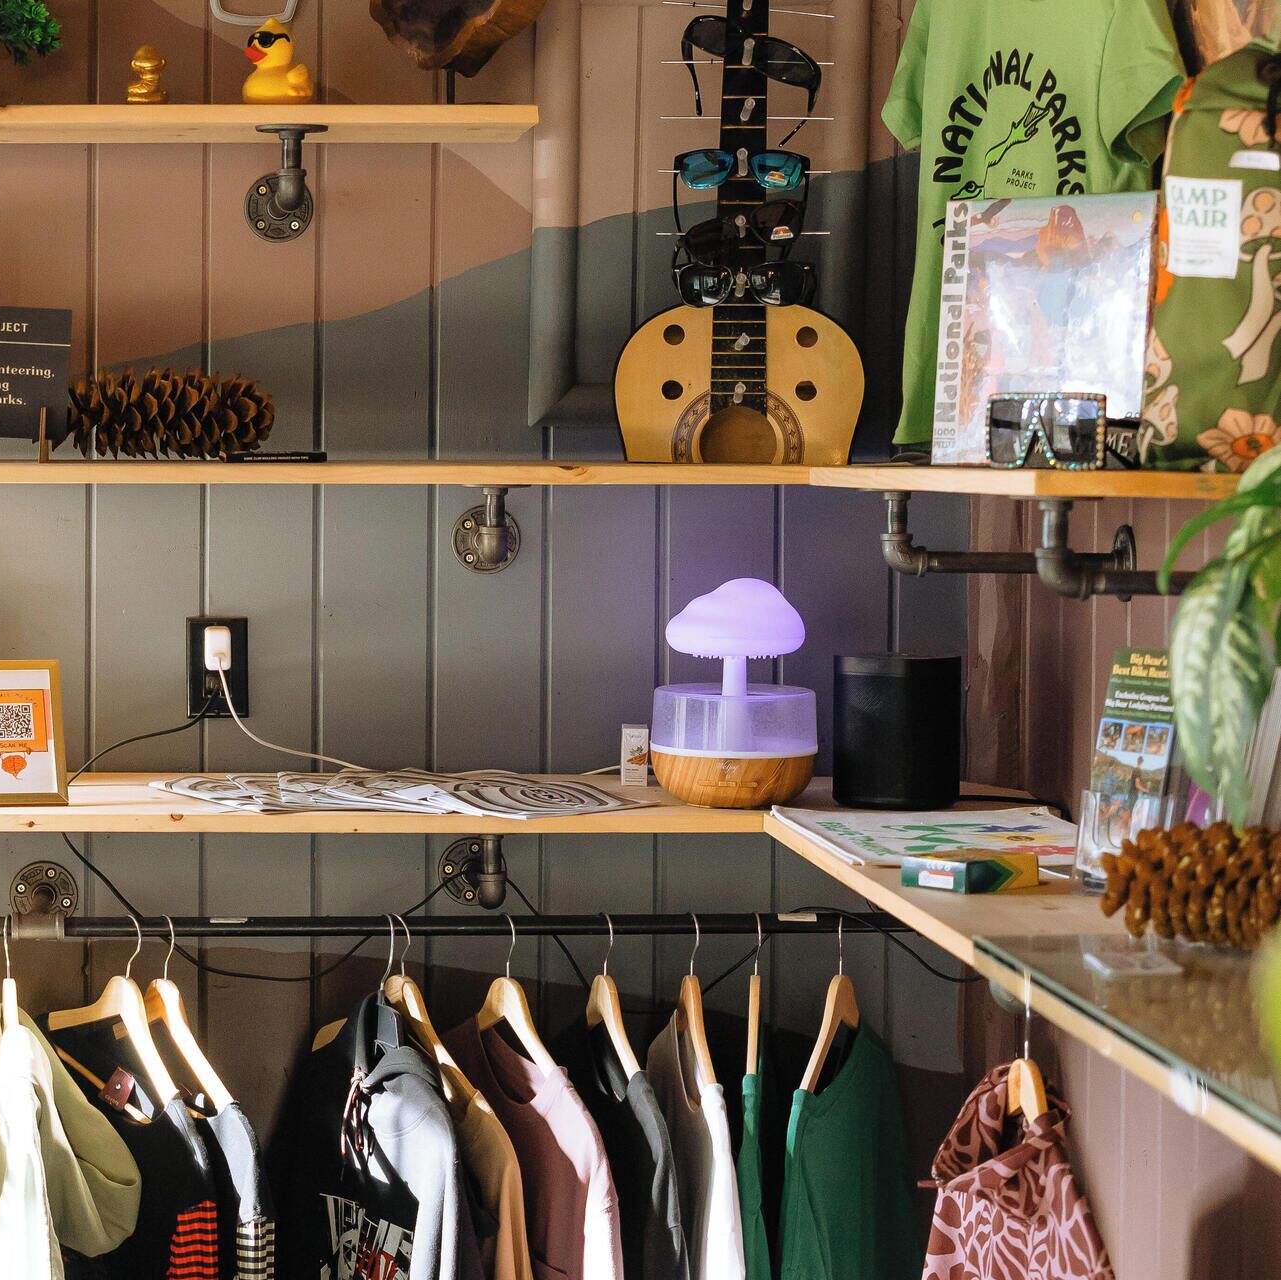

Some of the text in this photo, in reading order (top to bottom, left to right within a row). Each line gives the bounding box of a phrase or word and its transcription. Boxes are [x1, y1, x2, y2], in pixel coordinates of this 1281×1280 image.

[1006, 177, 1037, 191] PROJECT
[1011, 168, 1033, 180] PARKS
[944, 202, 969, 284] Parks
[936, 294, 963, 422] National
